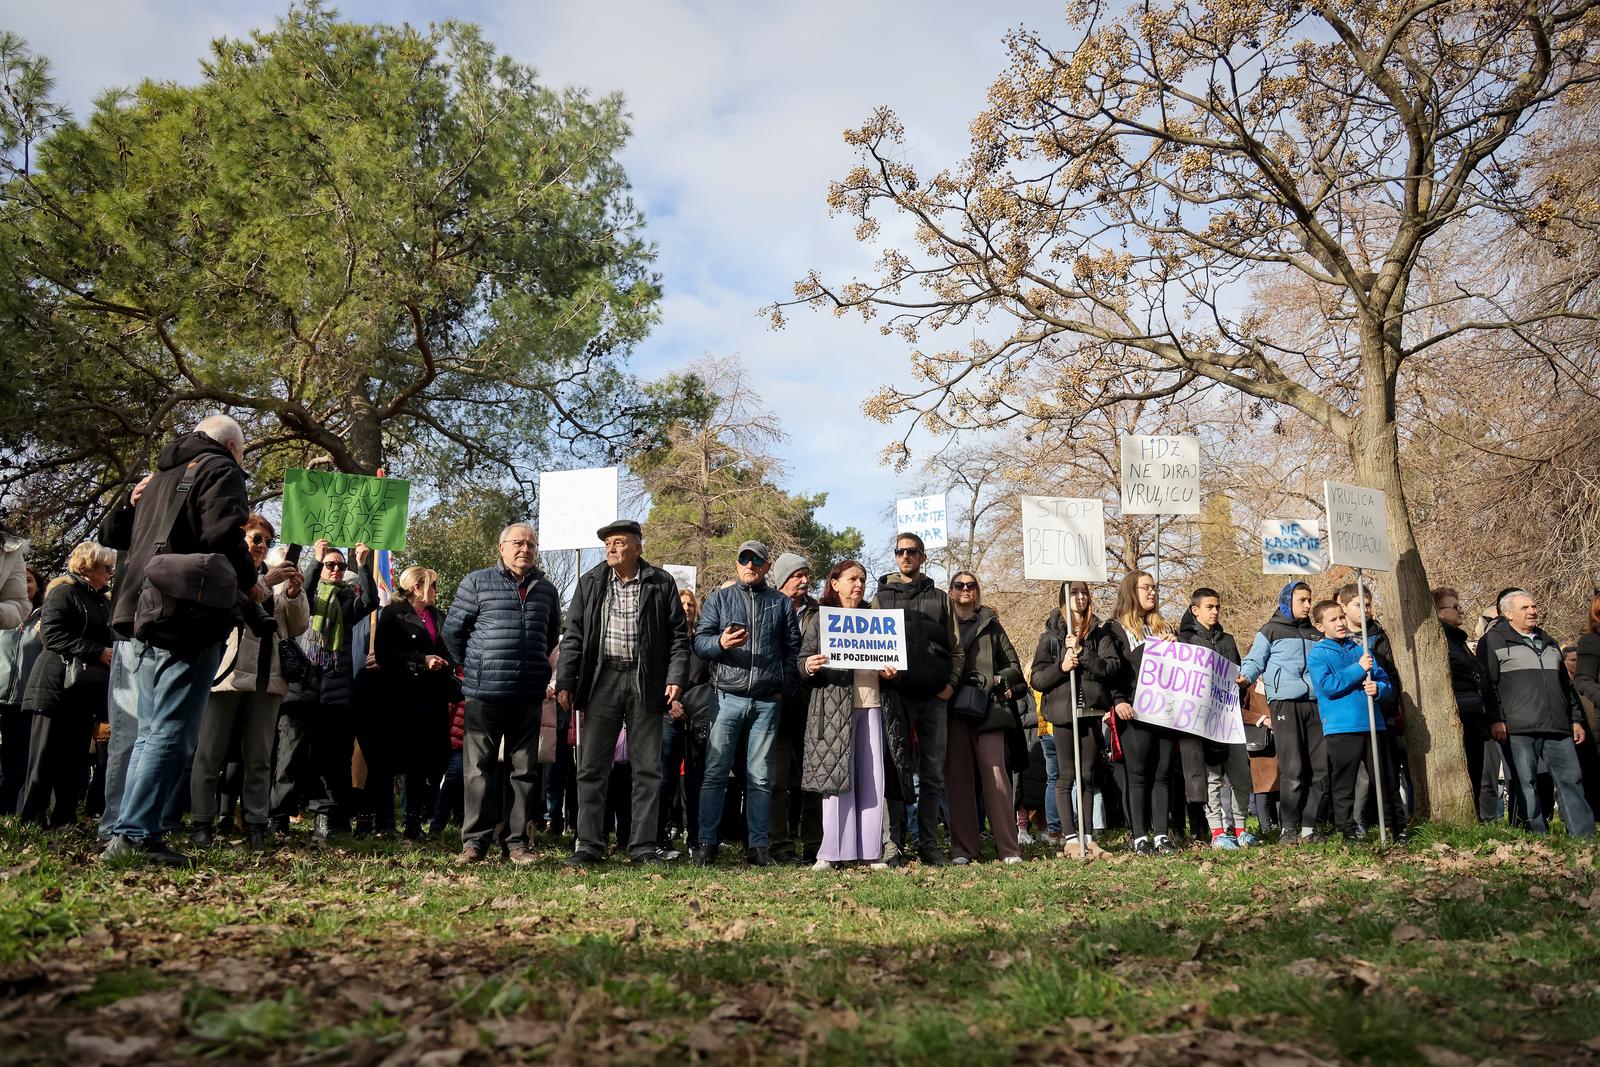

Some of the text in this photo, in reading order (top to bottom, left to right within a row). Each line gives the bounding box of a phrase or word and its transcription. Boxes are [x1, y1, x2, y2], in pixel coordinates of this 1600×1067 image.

[1130, 463, 1197, 479] NE DIRAJ
[302, 471, 398, 499] SVUGDJE
[328, 495, 387, 514] PRAVA
[914, 499, 929, 511] NE
[1037, 500, 1094, 519] STOP
[304, 509, 383, 526] NIGDJE
[1361, 515, 1374, 528] NA
[307, 523, 382, 544] PRAVDE
[1280, 523, 1300, 536] NE
[1027, 527, 1102, 567] BETONU
[1265, 537, 1320, 550] KASAPITE
[1336, 531, 1381, 553] PRODAJU
[1269, 552, 1309, 566] GRAD
[828, 614, 897, 635] ZADAR
[829, 637, 897, 650] ZADRANIMA!
[830, 653, 899, 662] NE POJEDINCIMA
[1144, 637, 1231, 679] ZADRANI
[1140, 659, 1210, 698] BUDITE
[1138, 688, 1166, 716] OD
[1173, 699, 1243, 741] BETONA
